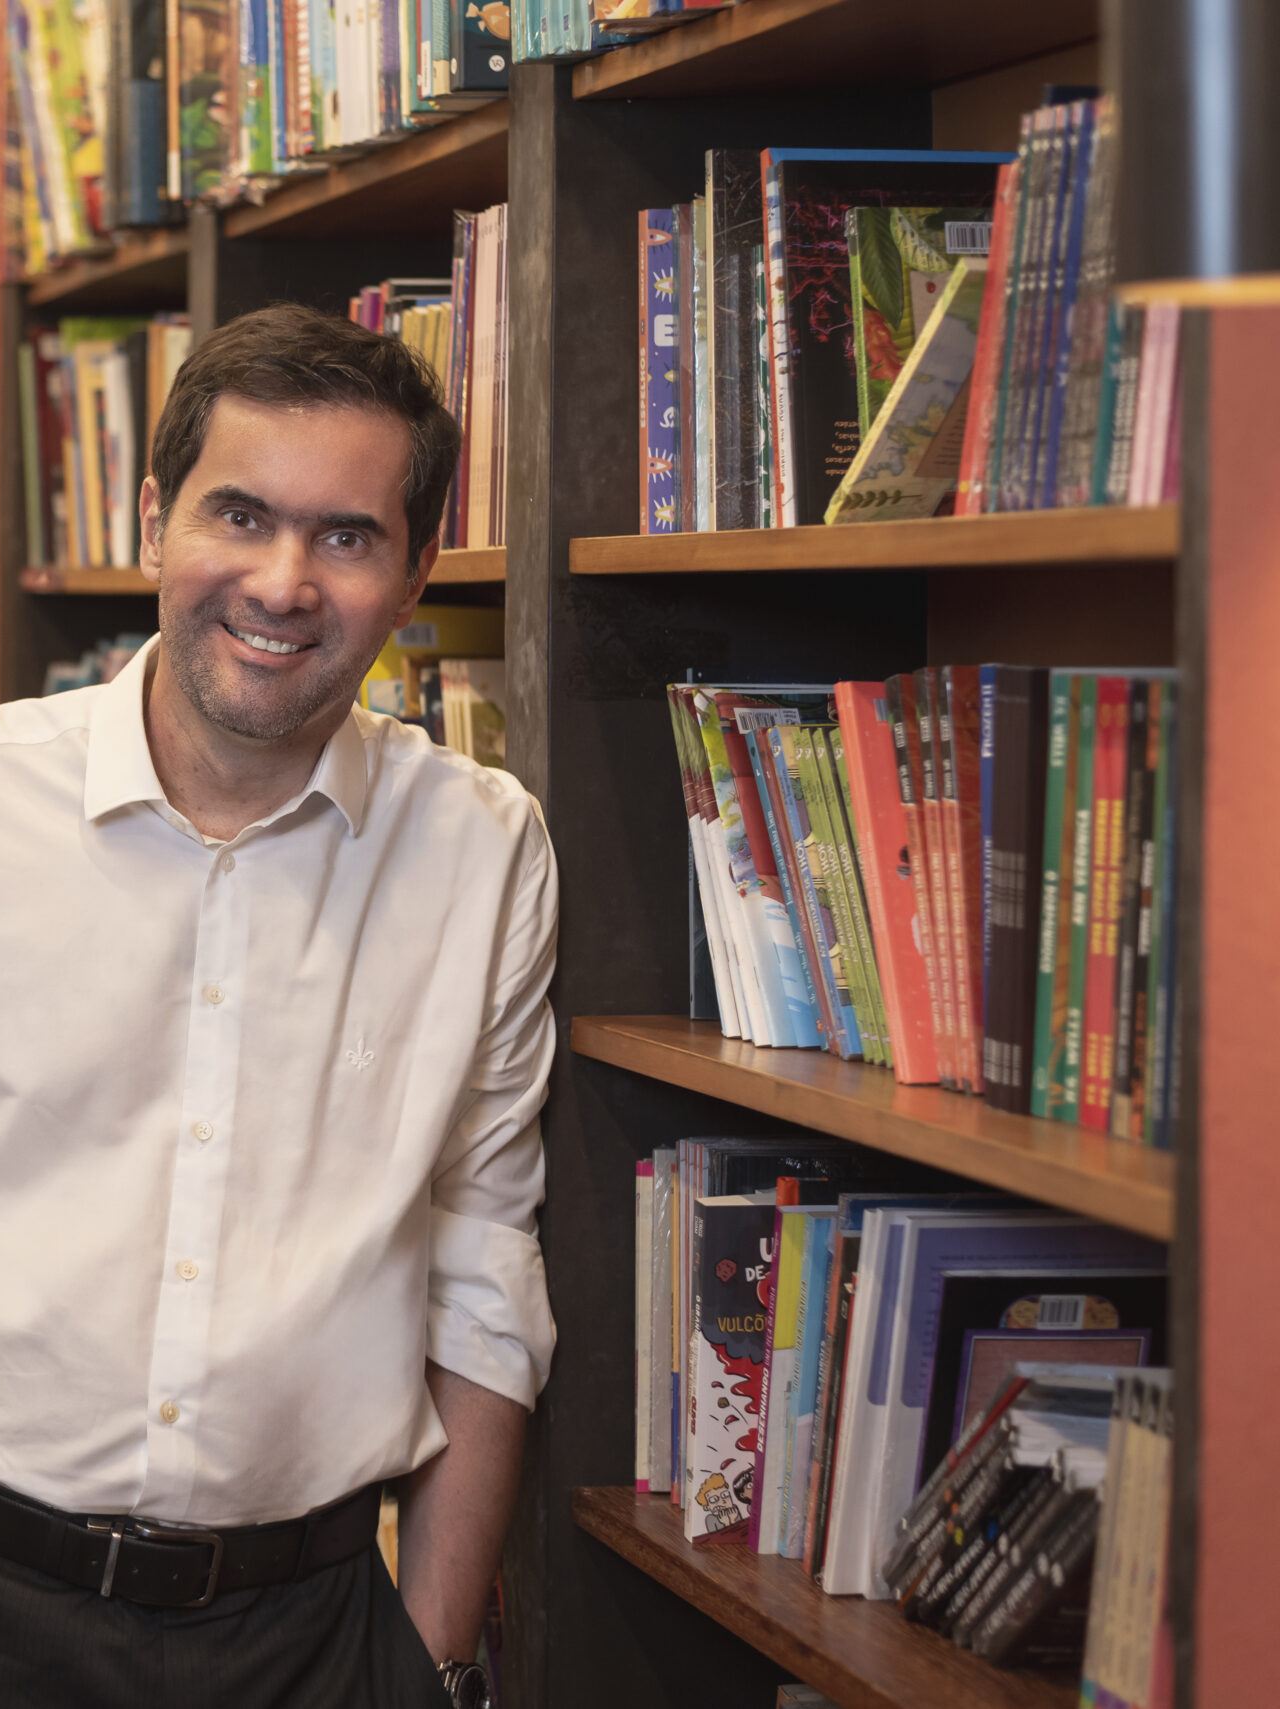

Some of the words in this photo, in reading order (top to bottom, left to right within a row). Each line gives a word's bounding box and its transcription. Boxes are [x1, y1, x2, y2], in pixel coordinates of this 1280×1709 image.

[980, 696, 994, 757] FROZEN
[1049, 723, 1066, 767] WELLS
[792, 838, 809, 873] THOR
[815, 839, 831, 875] THOR
[824, 841, 840, 877] THOR
[837, 842, 852, 877] THOR
[1073, 808, 1090, 886] VERONICA
[1071, 891, 1087, 925] ANN
[1091, 869, 1106, 918] UTOPIA
[1099, 1033, 1113, 1081] WELLS
[1106, 872, 1120, 918] UTOPIA
[1066, 1006, 1080, 1065] WELLS
[1086, 1031, 1100, 1077] WELLS
[744, 1264, 766, 1283] DE
[767, 1286, 777, 1314] ESCOLA
[762, 1347, 771, 1366] UMA
[755, 1367, 770, 1453] DESENHANDO
